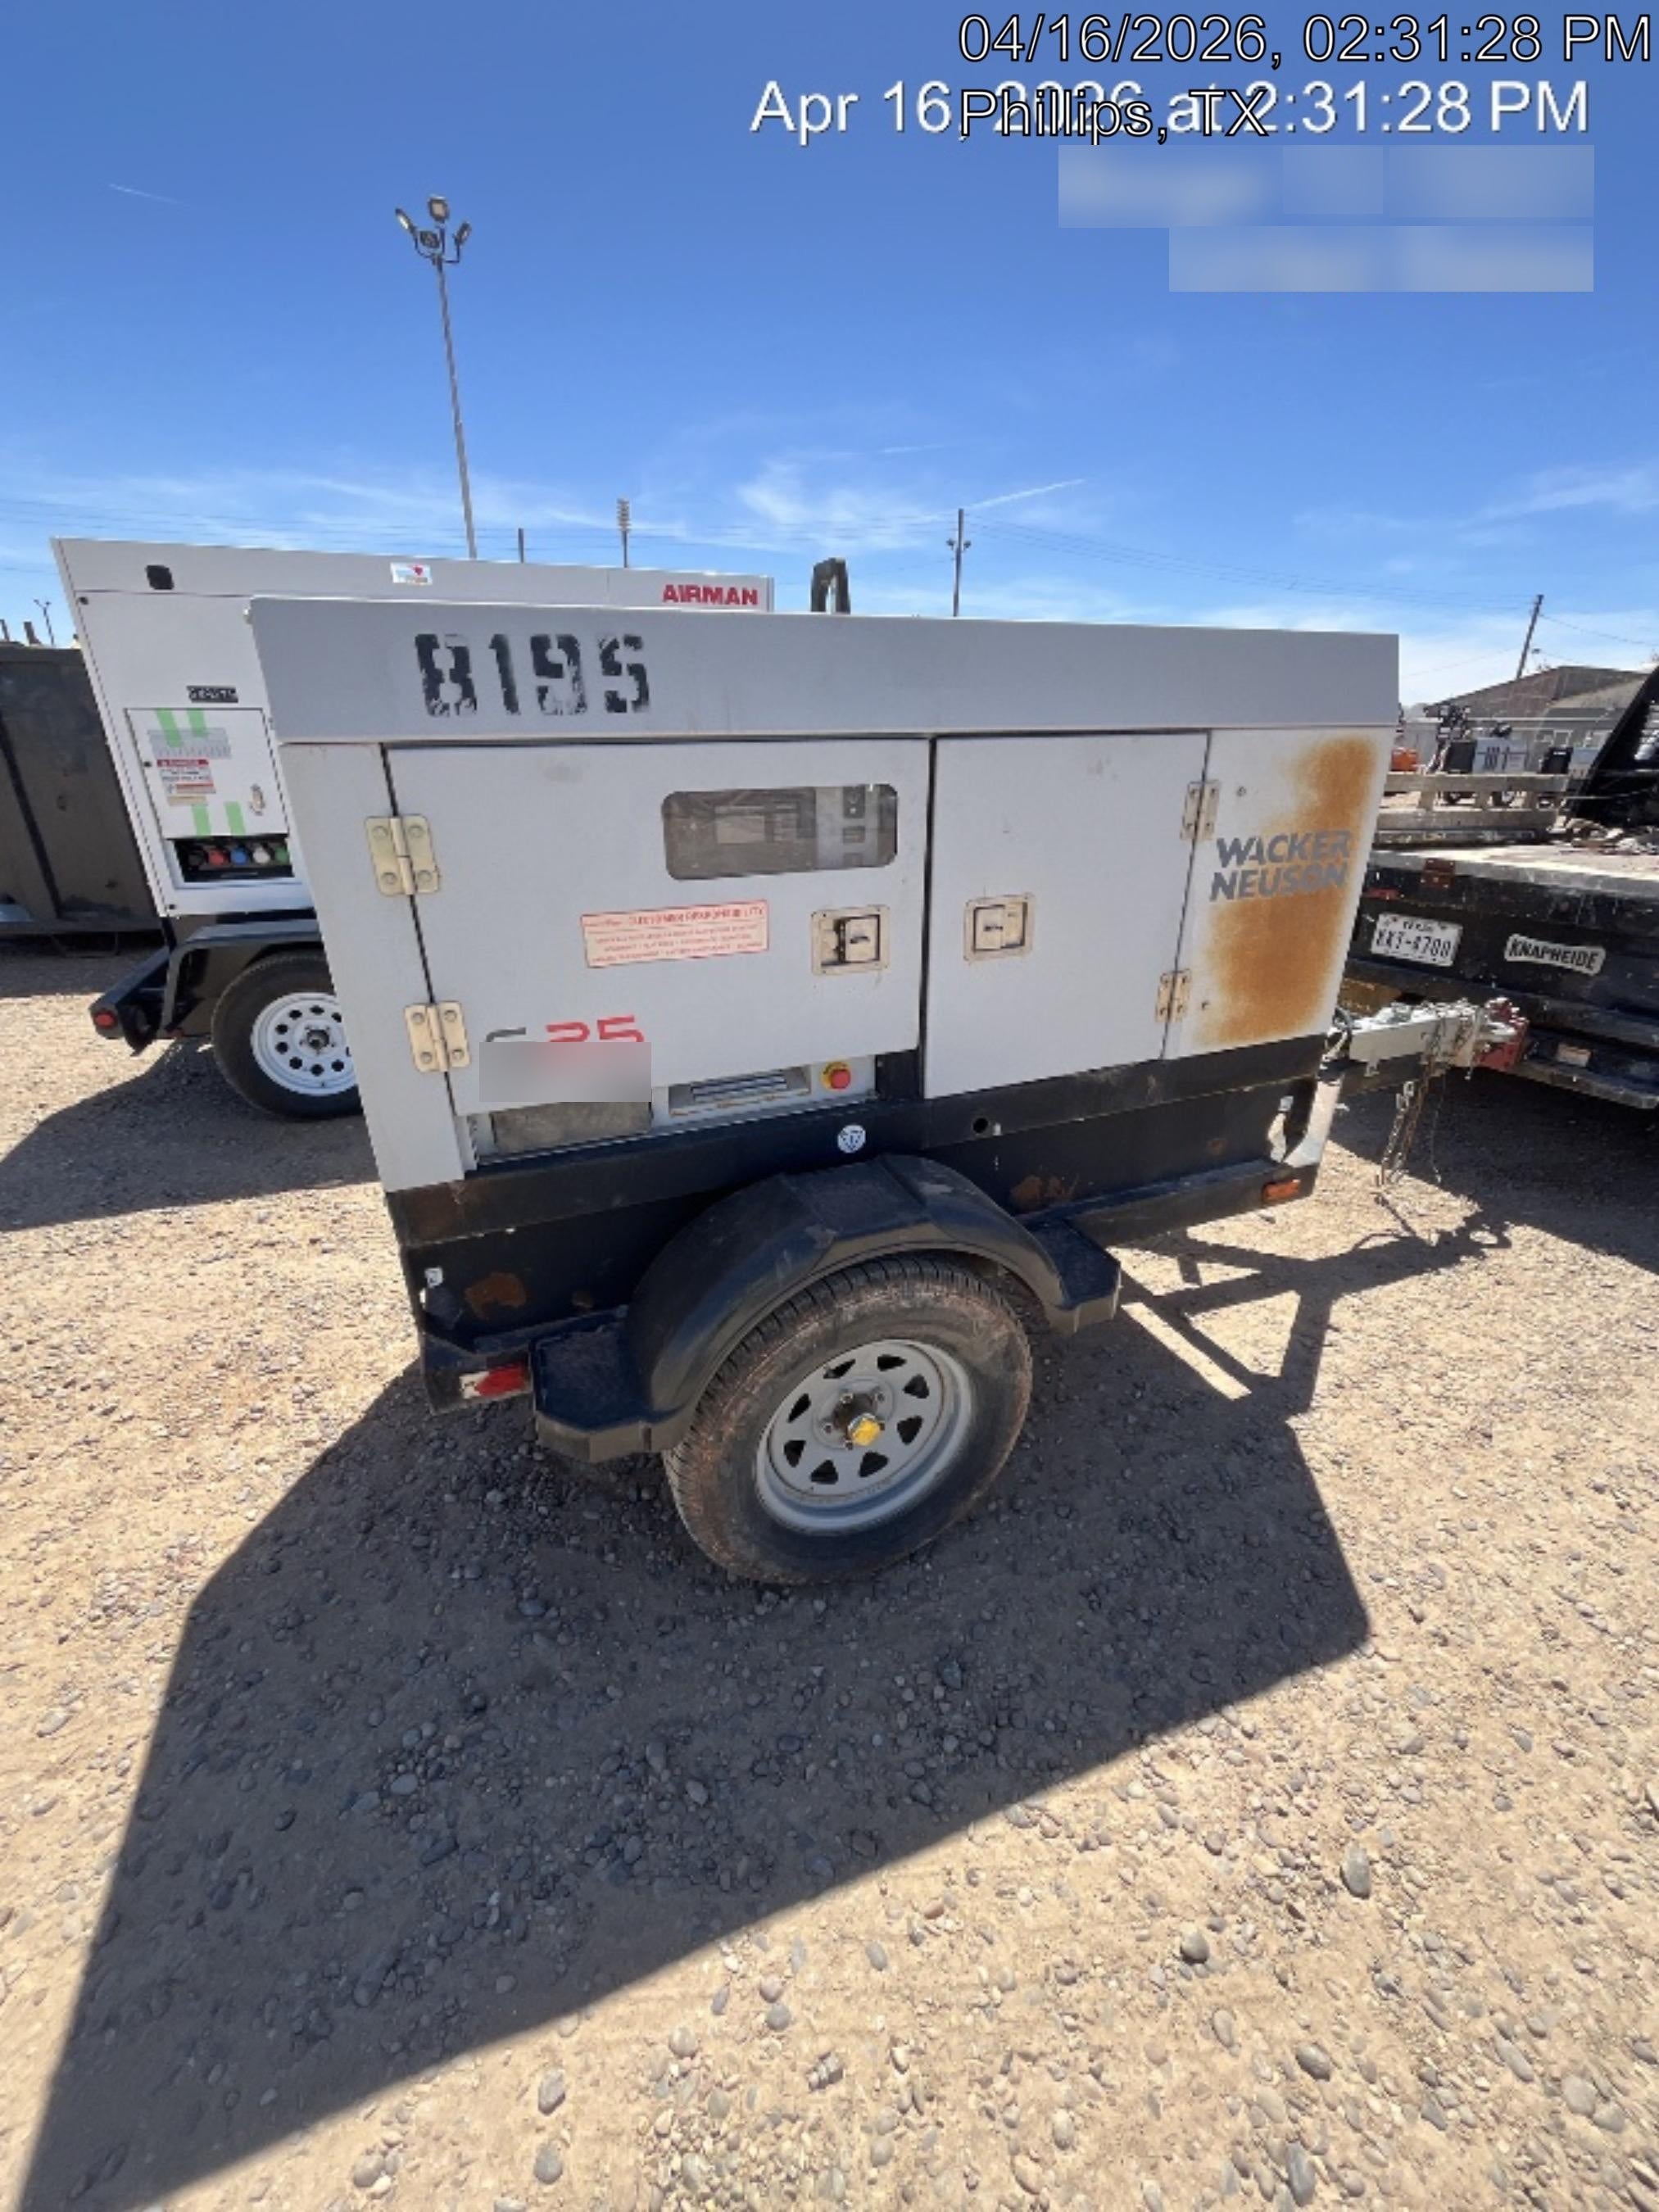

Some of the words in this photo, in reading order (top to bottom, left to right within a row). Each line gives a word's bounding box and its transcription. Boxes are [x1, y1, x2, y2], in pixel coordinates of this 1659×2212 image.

[662, 583, 759, 605] AIRMAN
[1216, 829, 1353, 868] WACKER
[1209, 862, 1349, 901] NEUSON
